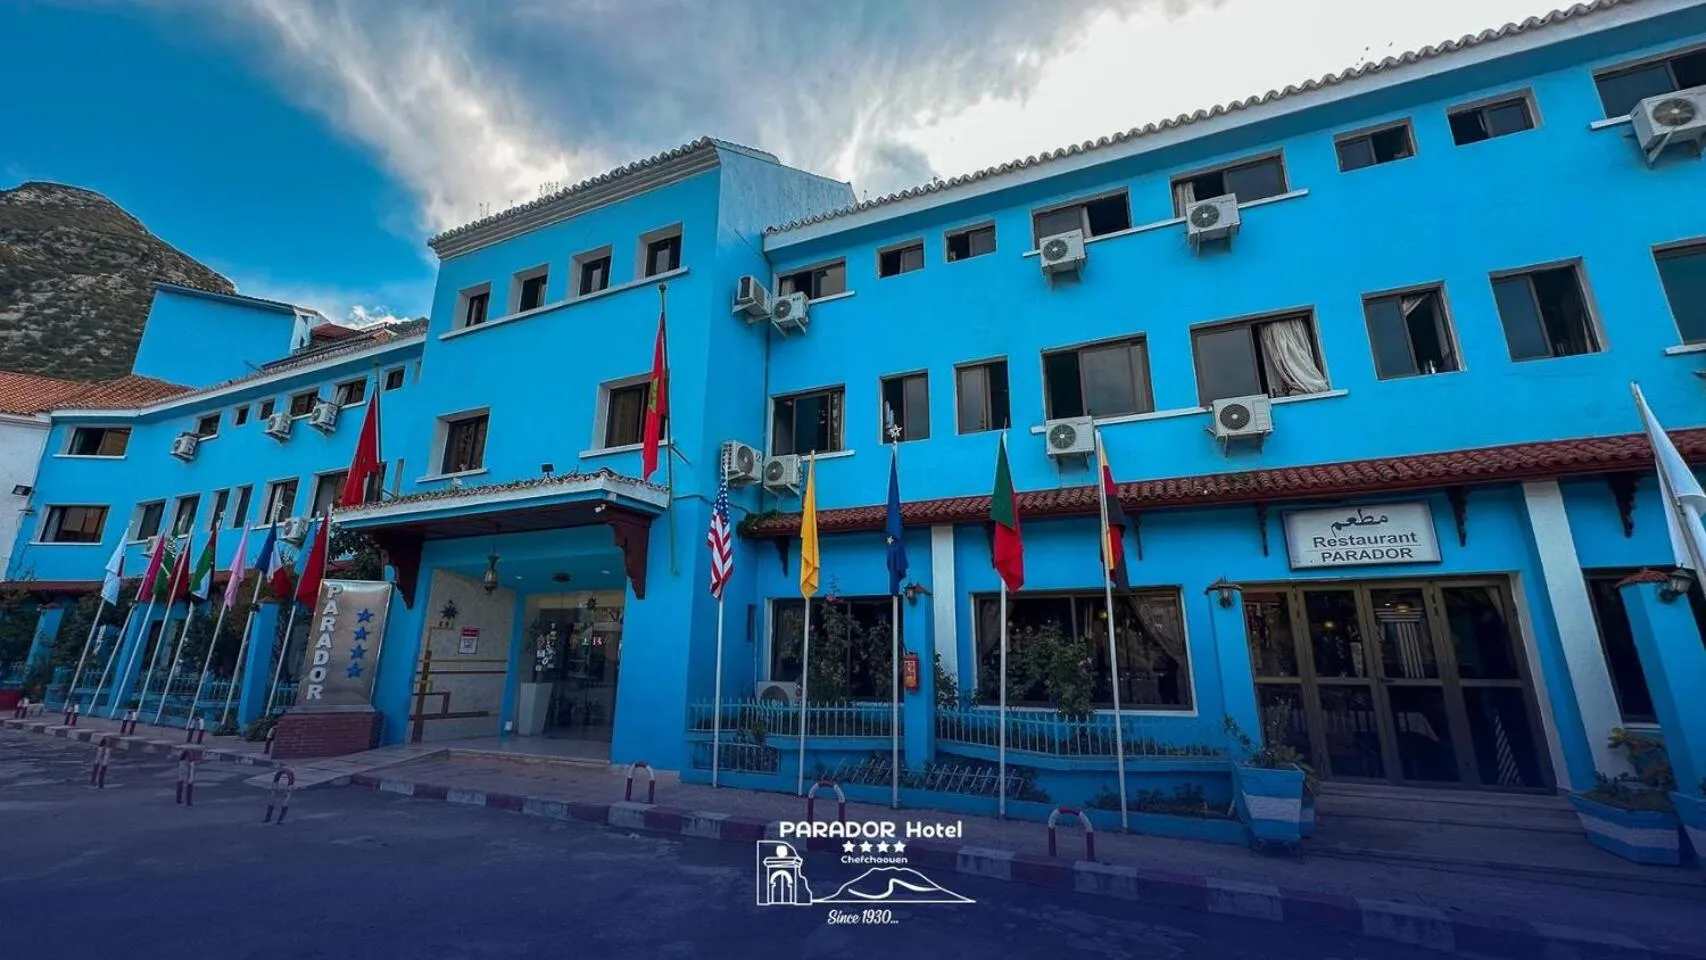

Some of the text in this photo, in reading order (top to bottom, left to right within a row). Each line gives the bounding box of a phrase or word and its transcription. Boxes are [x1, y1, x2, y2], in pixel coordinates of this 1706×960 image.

[1331, 508, 1389, 538] مطعم
[1313, 531, 1418, 548] Restaurant
[1321, 547, 1413, 562] PARADOR
[306, 583, 343, 700] PARADOR
